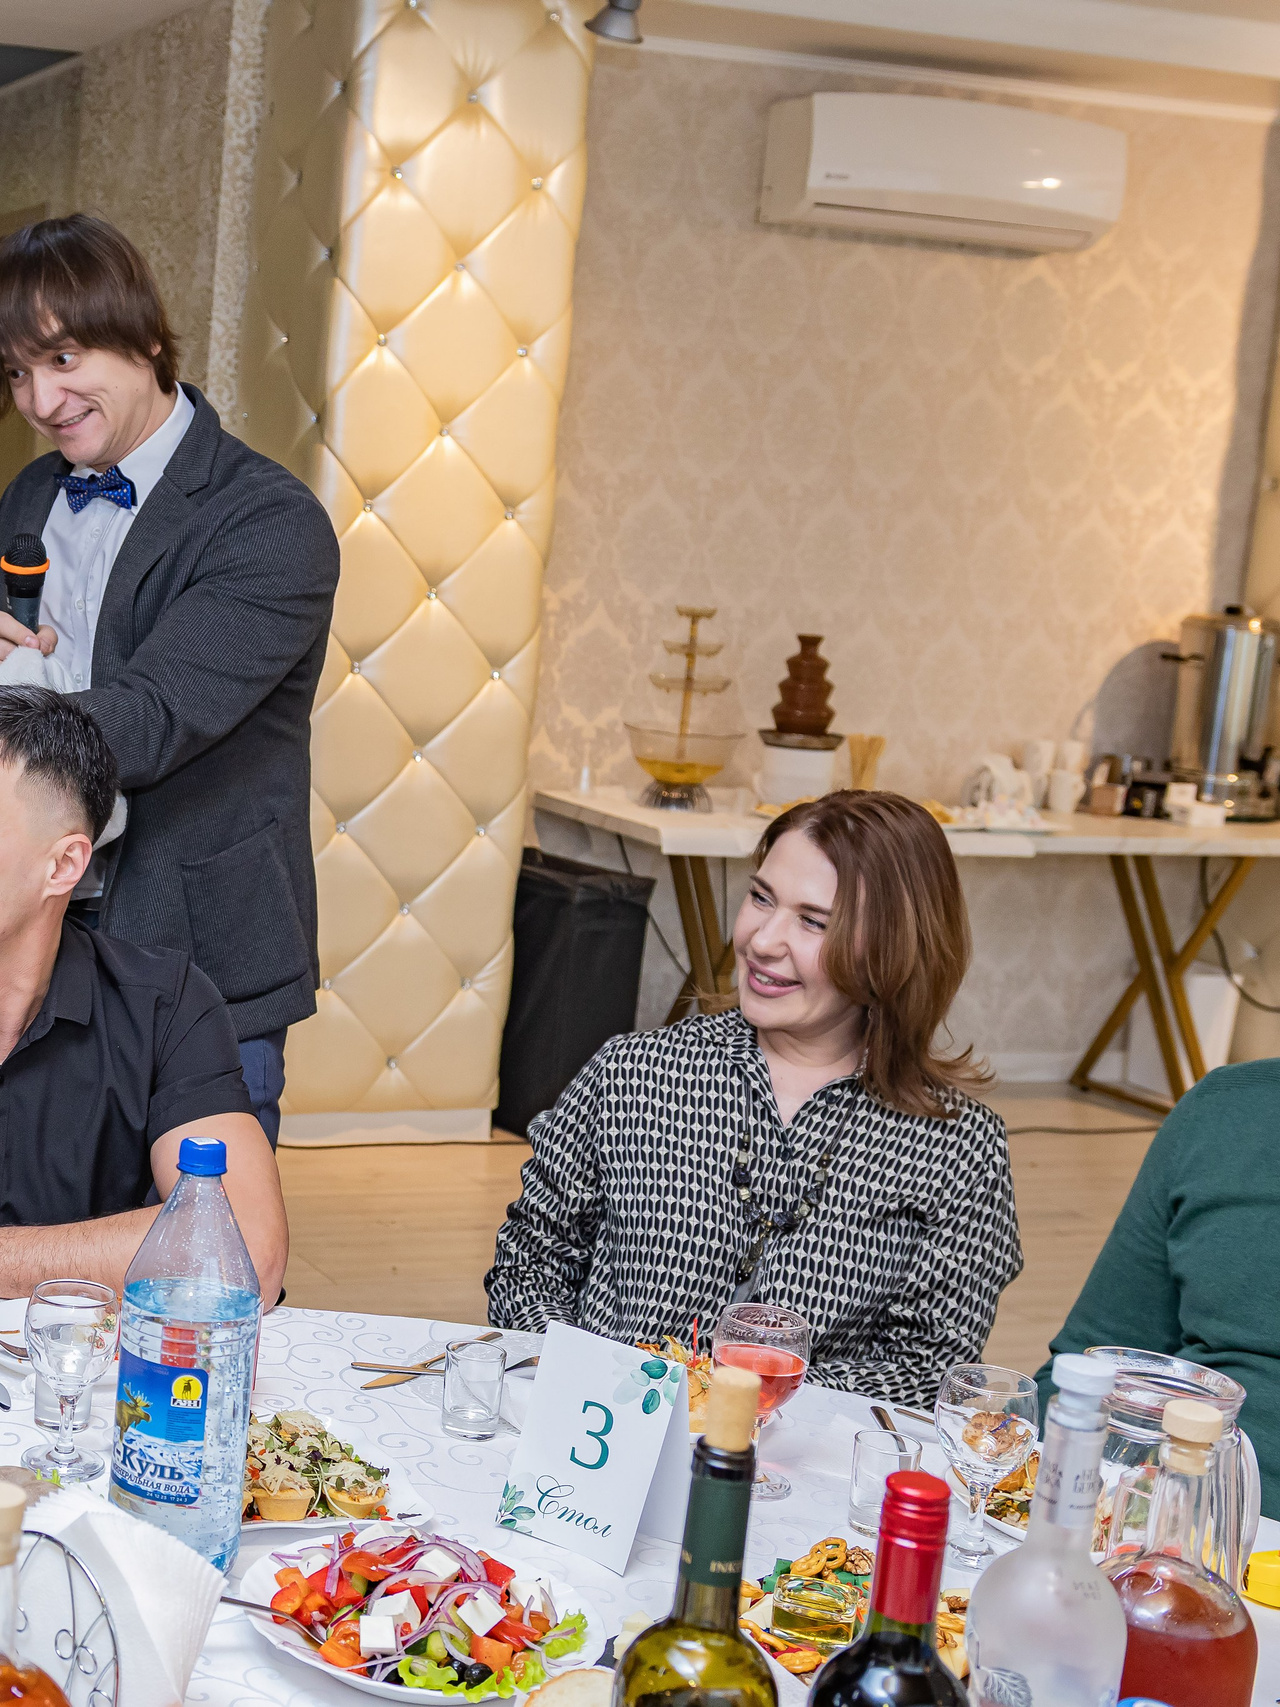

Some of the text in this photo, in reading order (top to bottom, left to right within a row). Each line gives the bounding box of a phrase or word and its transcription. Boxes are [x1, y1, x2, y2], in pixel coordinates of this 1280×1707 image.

[570, 1400, 614, 1470] 3
[163, 1484, 191, 1495] ВОДА
[536, 1474, 612, 1538] Стол
